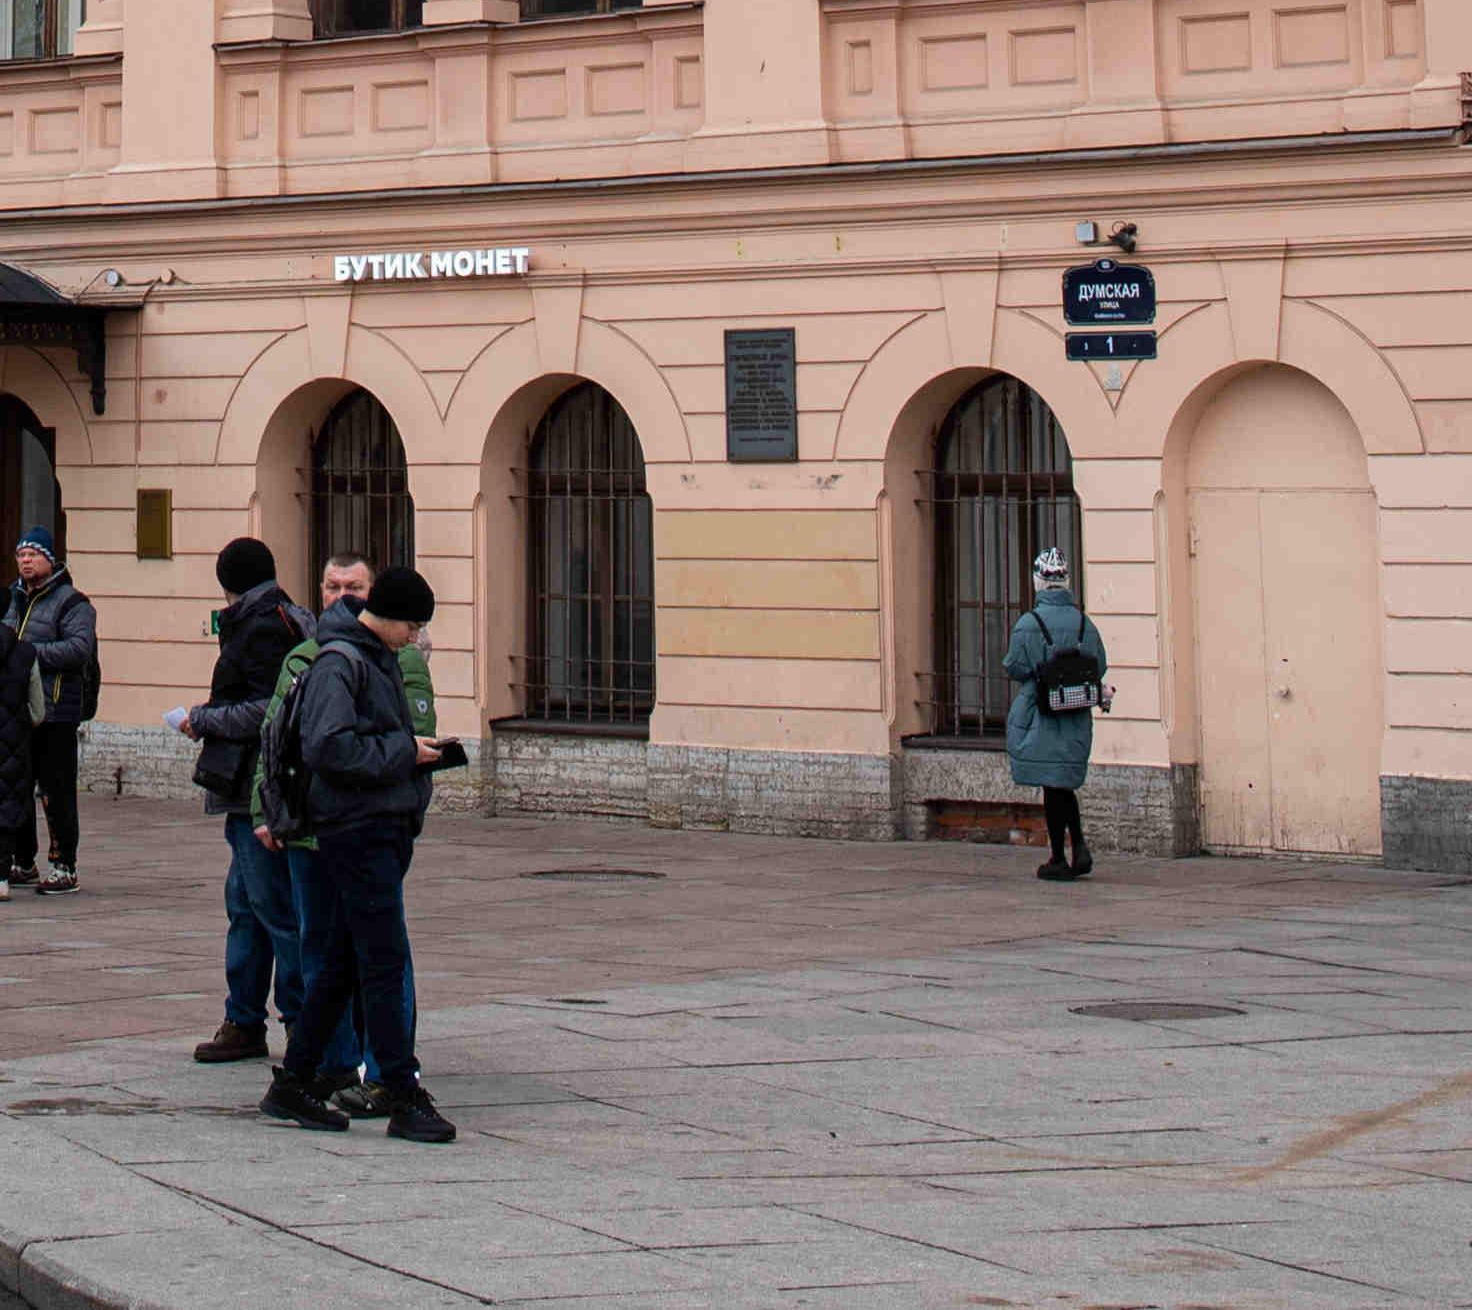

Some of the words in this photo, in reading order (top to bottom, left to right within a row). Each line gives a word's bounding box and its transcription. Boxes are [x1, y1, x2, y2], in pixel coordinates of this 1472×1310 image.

[334, 252, 429, 281] БУТИК
[430, 247, 529, 278] МОНЕТ
[1078, 282, 1140, 302] ДУМСКАЯ
[1106, 336, 1114, 354] 1
